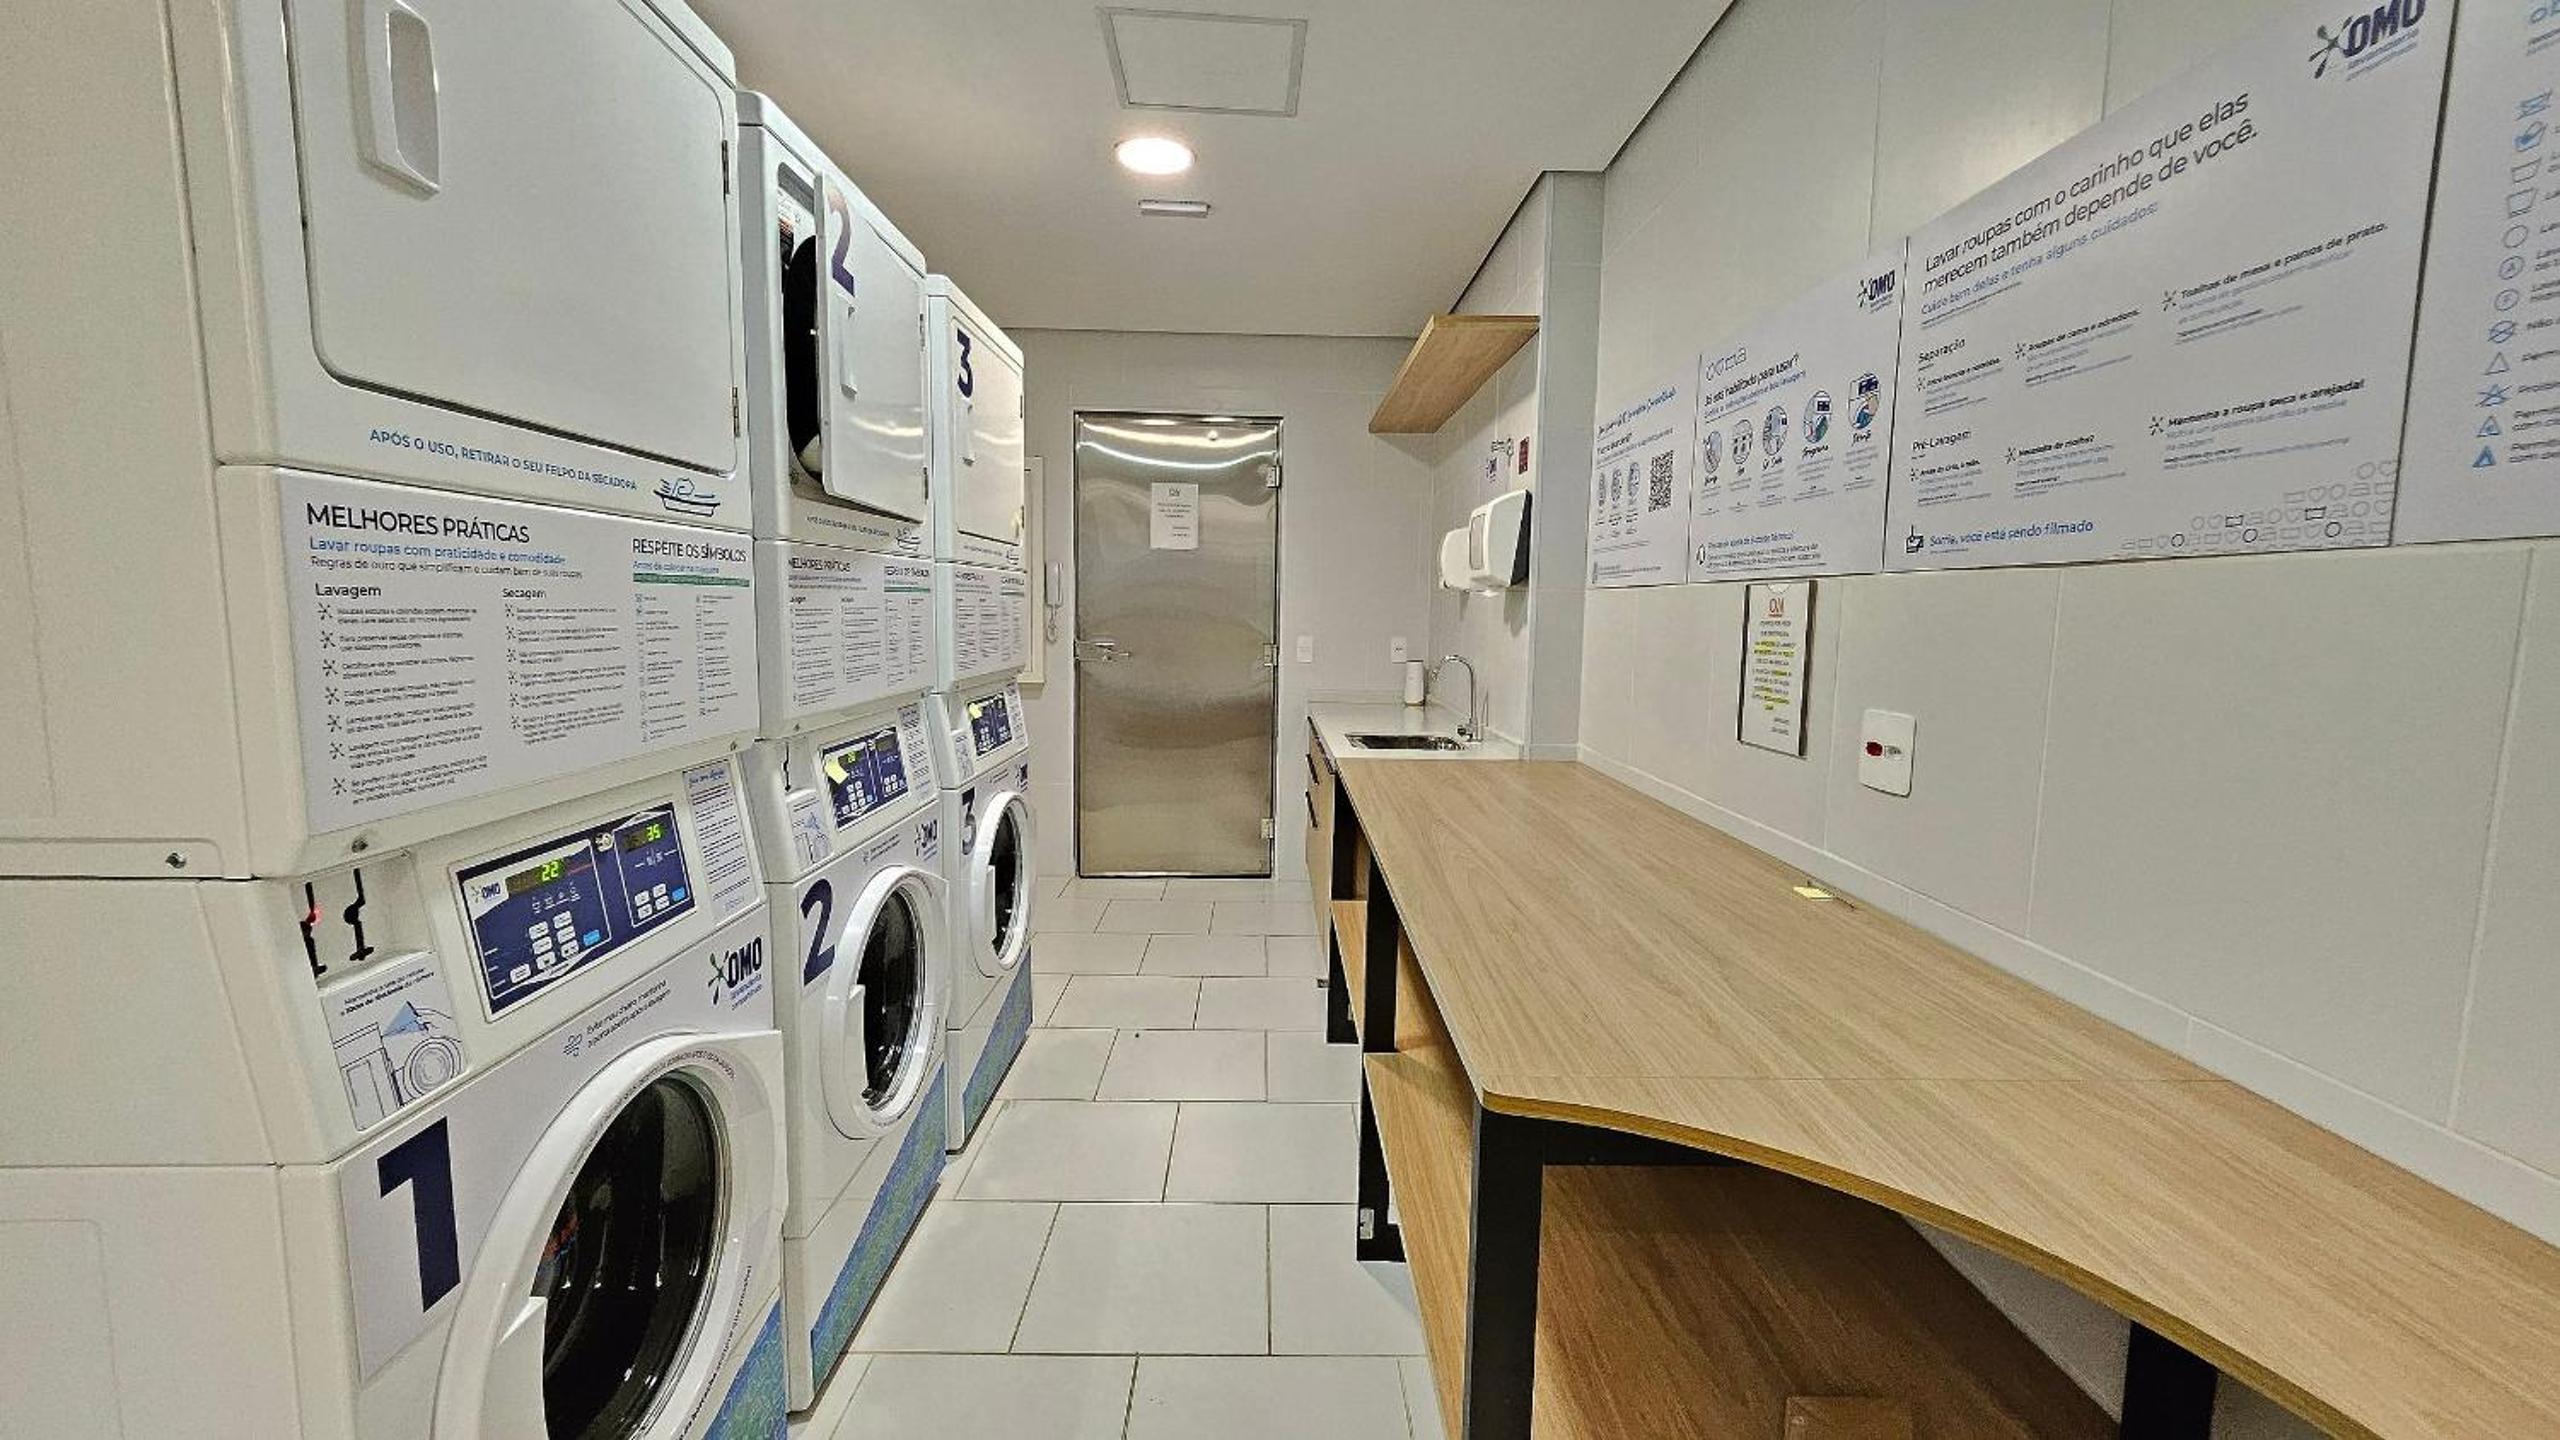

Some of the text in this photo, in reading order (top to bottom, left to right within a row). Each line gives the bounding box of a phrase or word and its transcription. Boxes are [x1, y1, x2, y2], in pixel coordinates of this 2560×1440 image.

[2342, 0, 2426, 58] OMO
[1925, 93, 2250, 273] Lavar roupas com o carinho que elas
[1923, 119, 2258, 295] merecem também depende de você.
[827, 188, 855, 297] 2
[2010, 254, 2044, 279] tenha
[2046, 235, 2090, 263] alguns
[2223, 273, 2238, 285] de
[2274, 258, 2281, 268] e
[2325, 237, 2343, 250] de
[1869, 269, 1895, 300] OMO
[957, 328, 973, 398] 3
[1918, 338, 1966, 365] Separação
[370, 429, 410, 448] APÓS
[414, 438, 424, 449] O
[428, 440, 459, 459] USO,
[462, 447, 509, 467] RETIRAR
[513, 458, 521, 469] O
[523, 459, 543, 473] SEU
[546, 463, 576, 479] FELPO
[578, 470, 591, 481] DA
[306, 502, 531, 543] MELHORES PRÁTICAS
[2008, 523, 2041, 542] sendo
[2043, 519, 2095, 537] filmado
[310, 536, 350, 552] Lavar
[354, 543, 401, 558] roupas
[403, 545, 431, 557] com
[434, 546, 497, 562] praticidade
[311, 556, 352, 570] Regras
[354, 557, 369, 569] de
[371, 560, 396, 571] ouro
[397, 561, 418, 574] que
[633, 538, 747, 562] RESPEITE OS SÍMBOLOS
[315, 582, 382, 600] Lavagem
[502, 588, 547, 600] Secagem
[961, 787, 976, 855] 3
[482, 883, 502, 899] OMO
[541, 861, 559, 882] 22
[800, 879, 835, 987] 2
[727, 936, 762, 989] OMO
[377, 1116, 461, 1313] 1
